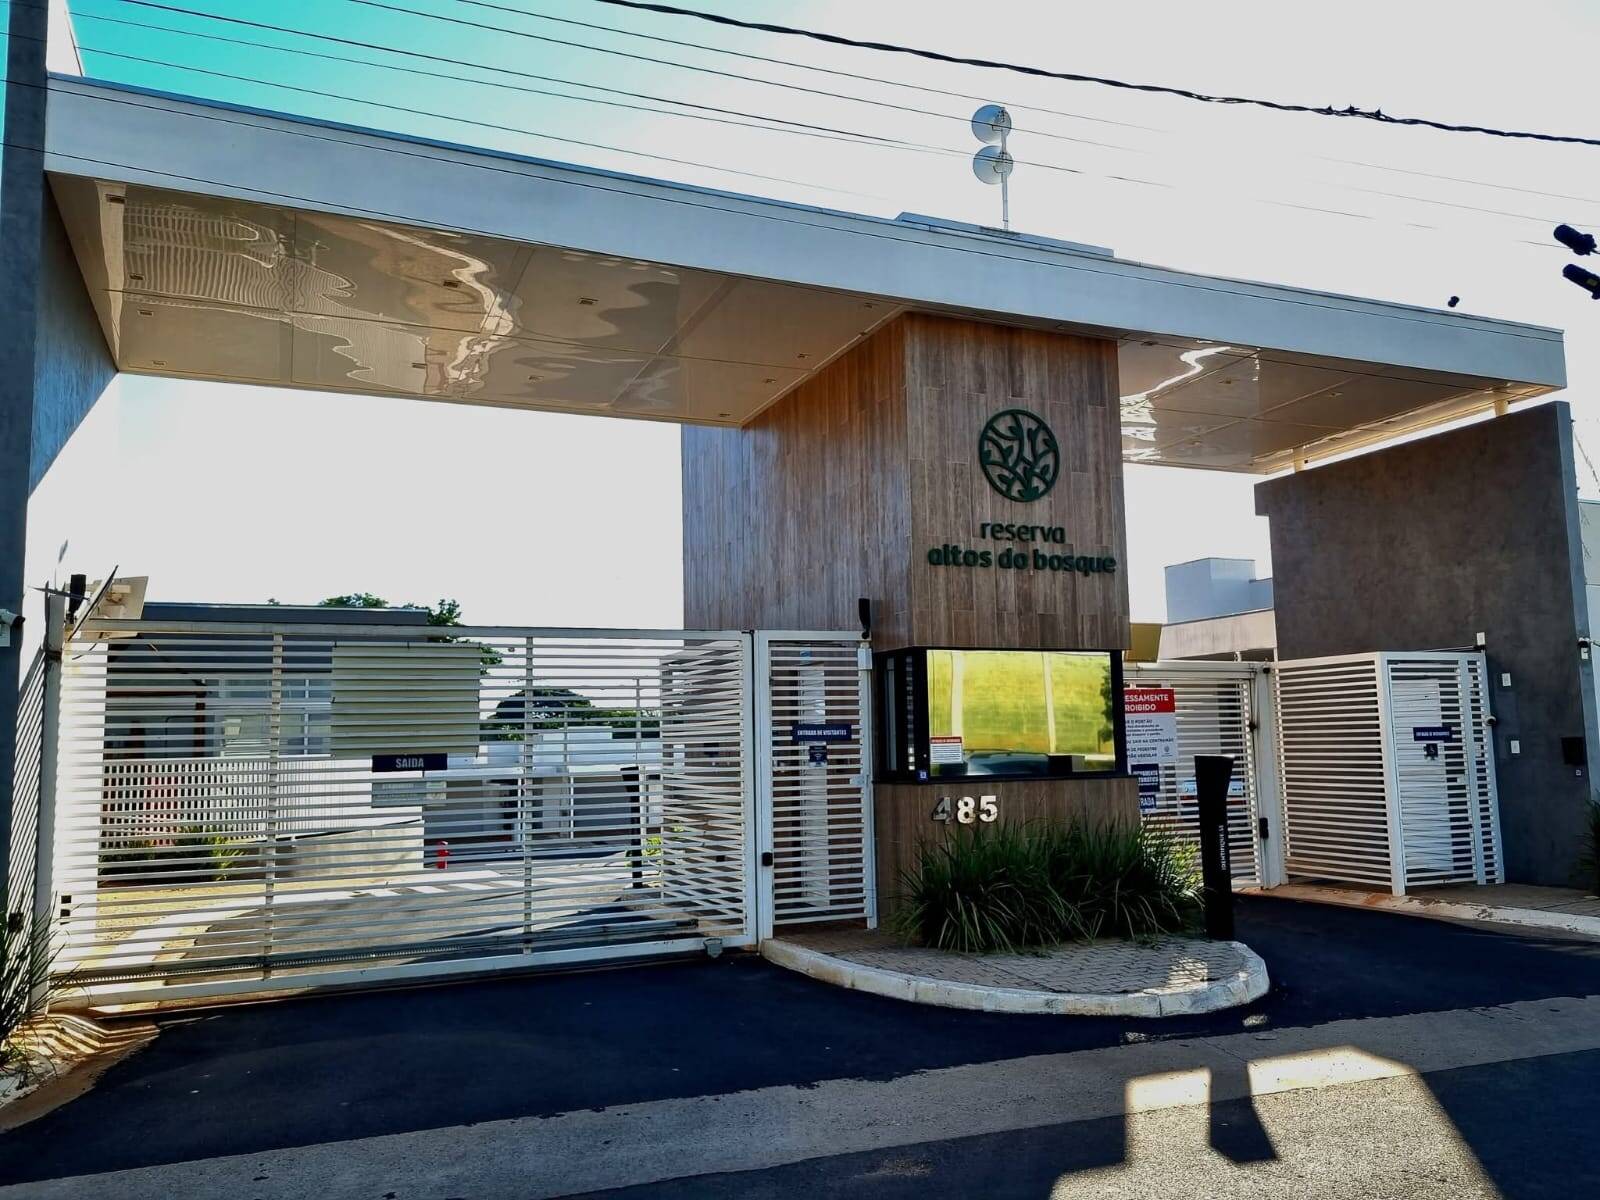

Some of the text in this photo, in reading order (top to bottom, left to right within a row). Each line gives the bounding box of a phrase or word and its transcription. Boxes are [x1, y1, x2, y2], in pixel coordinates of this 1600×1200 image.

[980, 522, 1065, 543] reserva
[927, 544, 1117, 577] altos do bosque
[1125, 694, 1169, 702] ESSAMENTE
[1125, 703, 1157, 712] ROIBIDO
[932, 795, 998, 825] 485
